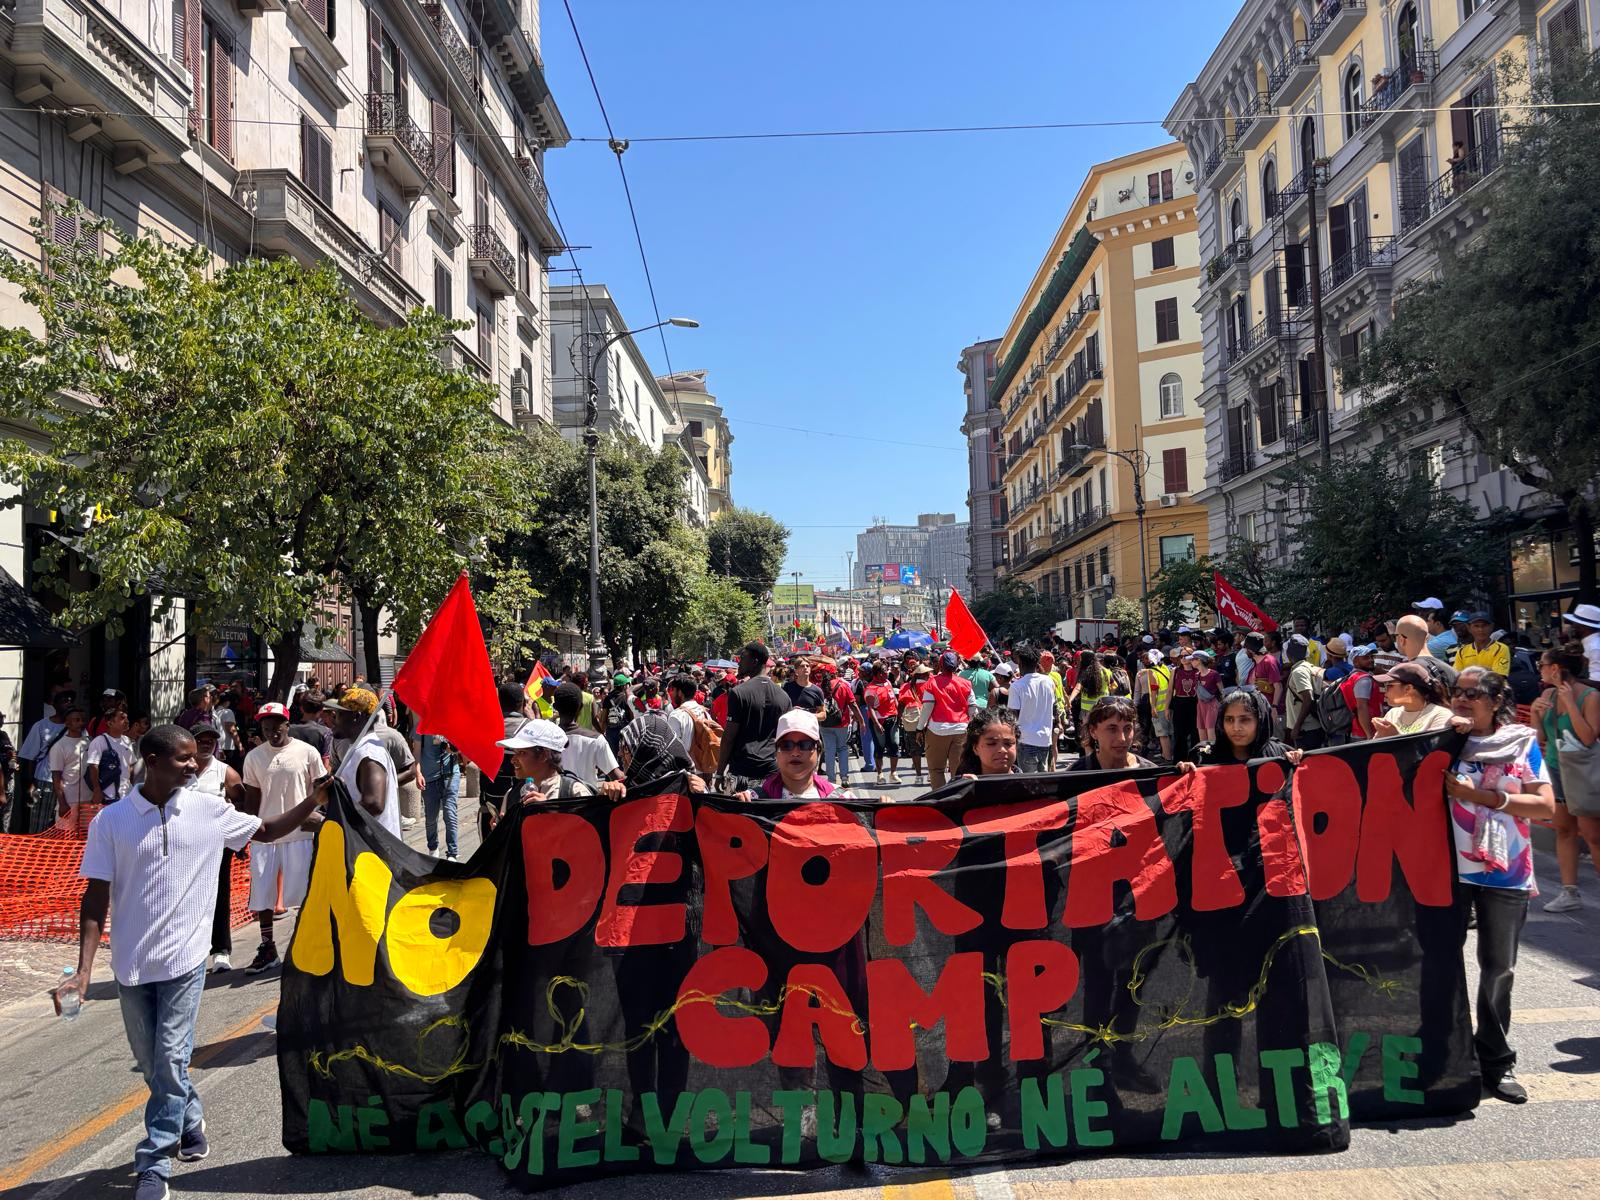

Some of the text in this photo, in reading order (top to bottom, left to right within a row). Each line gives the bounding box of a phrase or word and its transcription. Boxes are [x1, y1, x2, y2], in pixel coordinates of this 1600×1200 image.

[291, 820, 498, 996] NO
[675, 939, 1081, 1072] CAMP
[308, 1094, 391, 1153] NÉ
[1021, 1047, 1114, 1150] NÉ
